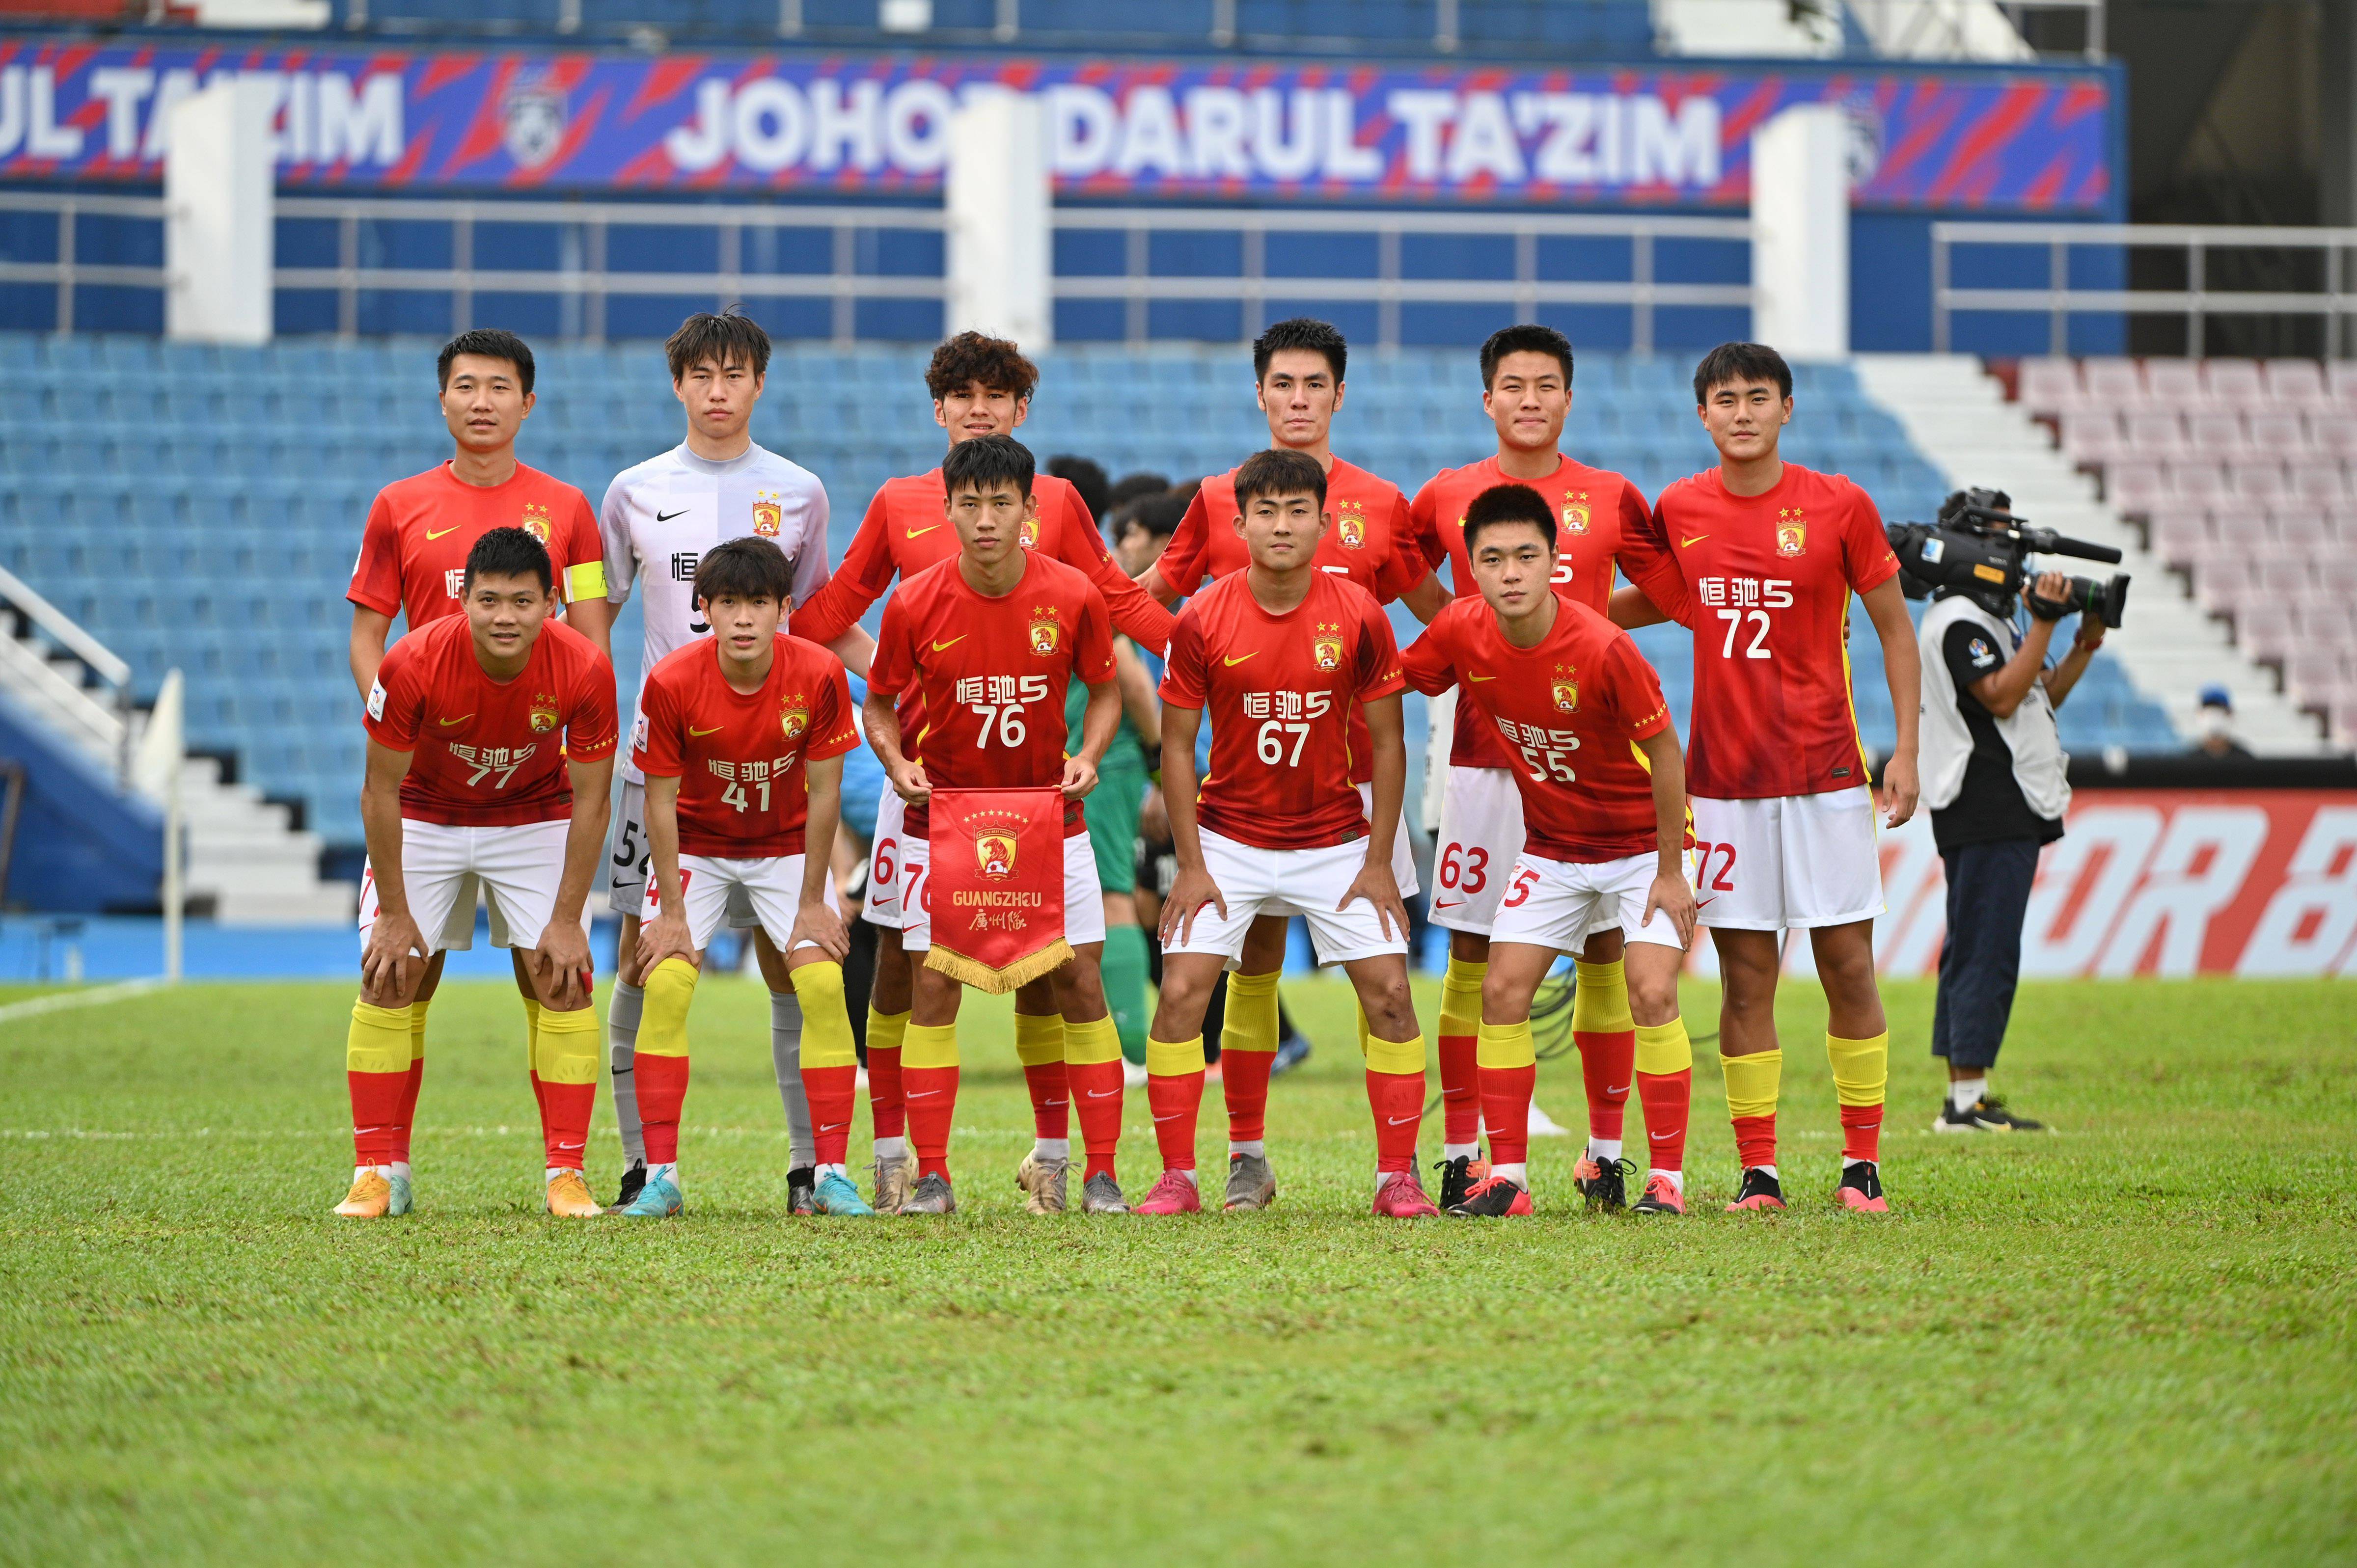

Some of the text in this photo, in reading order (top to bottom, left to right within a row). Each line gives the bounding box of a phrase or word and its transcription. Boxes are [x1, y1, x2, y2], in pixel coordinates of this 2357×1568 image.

[89, 68, 404, 164] TAIM
[665, 78, 1722, 185] JOHO DARUL TA'ZIM
[1699, 577, 1793, 608] 恒驰5
[1717, 609, 1771, 659] 72
[956, 675, 1048, 705] 恒驰5
[1243, 690, 1332, 720] 恒驰5
[972, 704, 1026, 749] 76
[1257, 720, 1310, 767] 67
[467, 762, 520, 789] 77
[708, 750, 797, 782] 恒驰5
[1521, 746, 1576, 783] 55
[721, 782, 770, 813] 41
[875, 838, 899, 885] 6
[1440, 842, 1489, 894] 63
[1696, 841, 1737, 891] 72
[953, 891, 1041, 907] GUANGZHOU
[1501, 865, 1540, 907] 5
[968, 909, 1027, 931] 廣州隊
